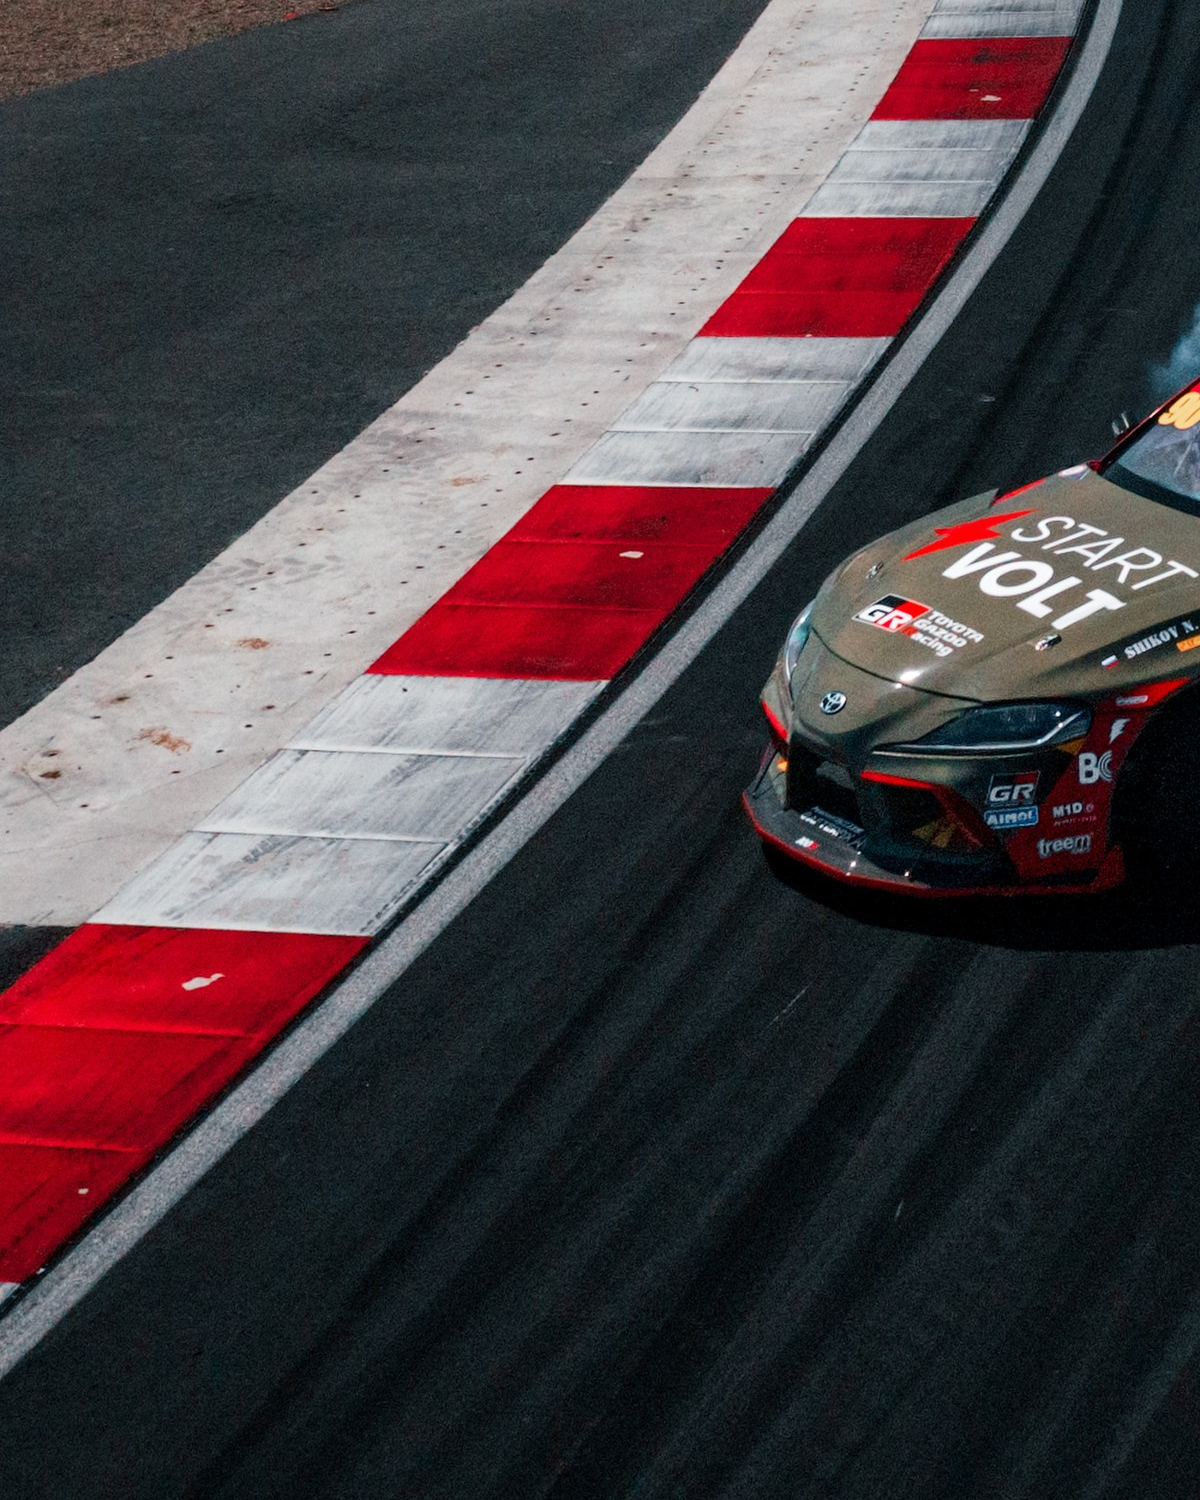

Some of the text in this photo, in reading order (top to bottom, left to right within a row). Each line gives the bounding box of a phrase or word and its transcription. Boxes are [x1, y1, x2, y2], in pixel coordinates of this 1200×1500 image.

[1011, 516, 1199, 591] START
[942, 542, 1127, 630] VOLT
[858, 604, 913, 630] GR
[928, 610, 984, 643] TOYOTA
[901, 625, 954, 657] Racing
[912, 618, 967, 647] GAZOO
[1124, 625, 1178, 659] SHIKOV
[1181, 619, 1199, 633] N.
[989, 783, 1035, 802] GR
[1052, 802, 1083, 818] M1D
[1037, 834, 1091, 858] freem
